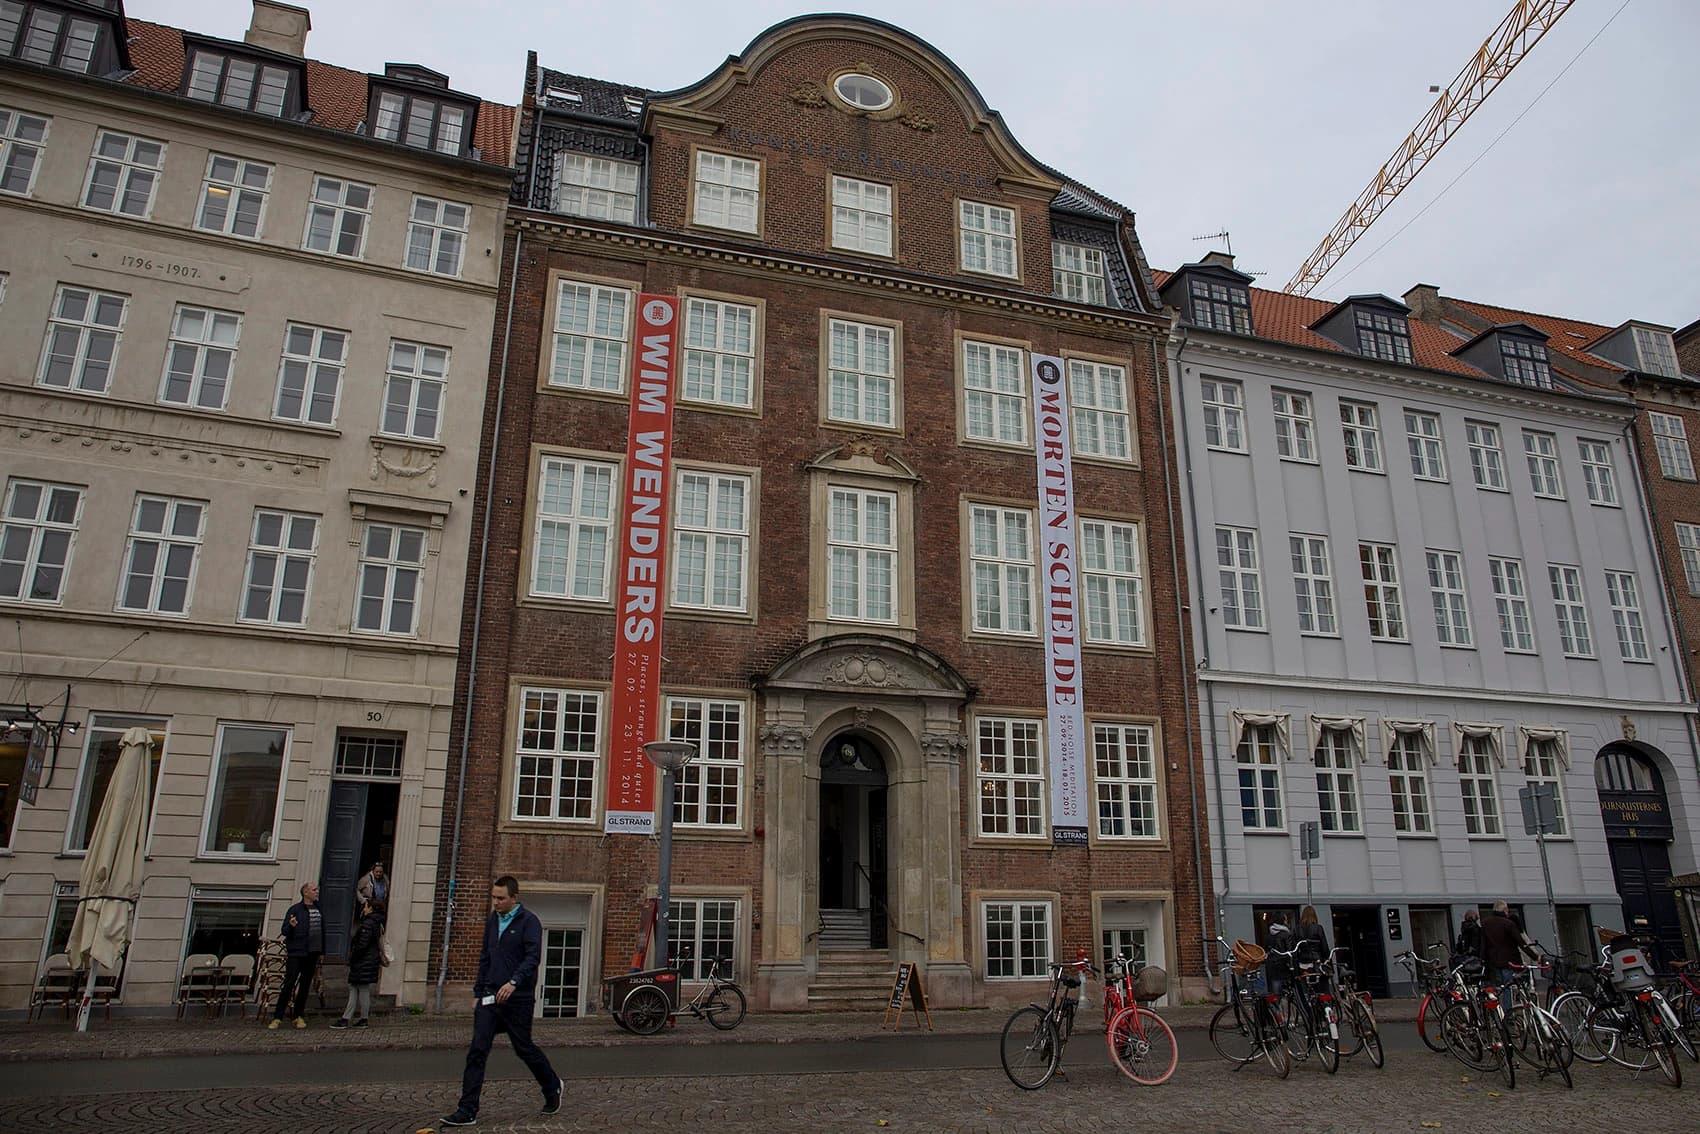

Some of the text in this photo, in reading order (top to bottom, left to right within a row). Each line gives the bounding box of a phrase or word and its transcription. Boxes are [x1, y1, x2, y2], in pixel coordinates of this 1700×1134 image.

[728, 127, 990, 189] KUNSTFORENINGEN
[624, 334, 670, 643] WIM WENDERS
[1040, 387, 1076, 705] MORTEN SCHELDE
[366, 711, 382, 721] 50
[636, 699, 645, 742] strange
[636, 746, 644, 769] and
[1067, 734, 1075, 760] NOISE
[621, 775, 631, 804] 2014
[634, 772, 642, 804] quiet
[1069, 764, 1077, 817] MEDITATION
